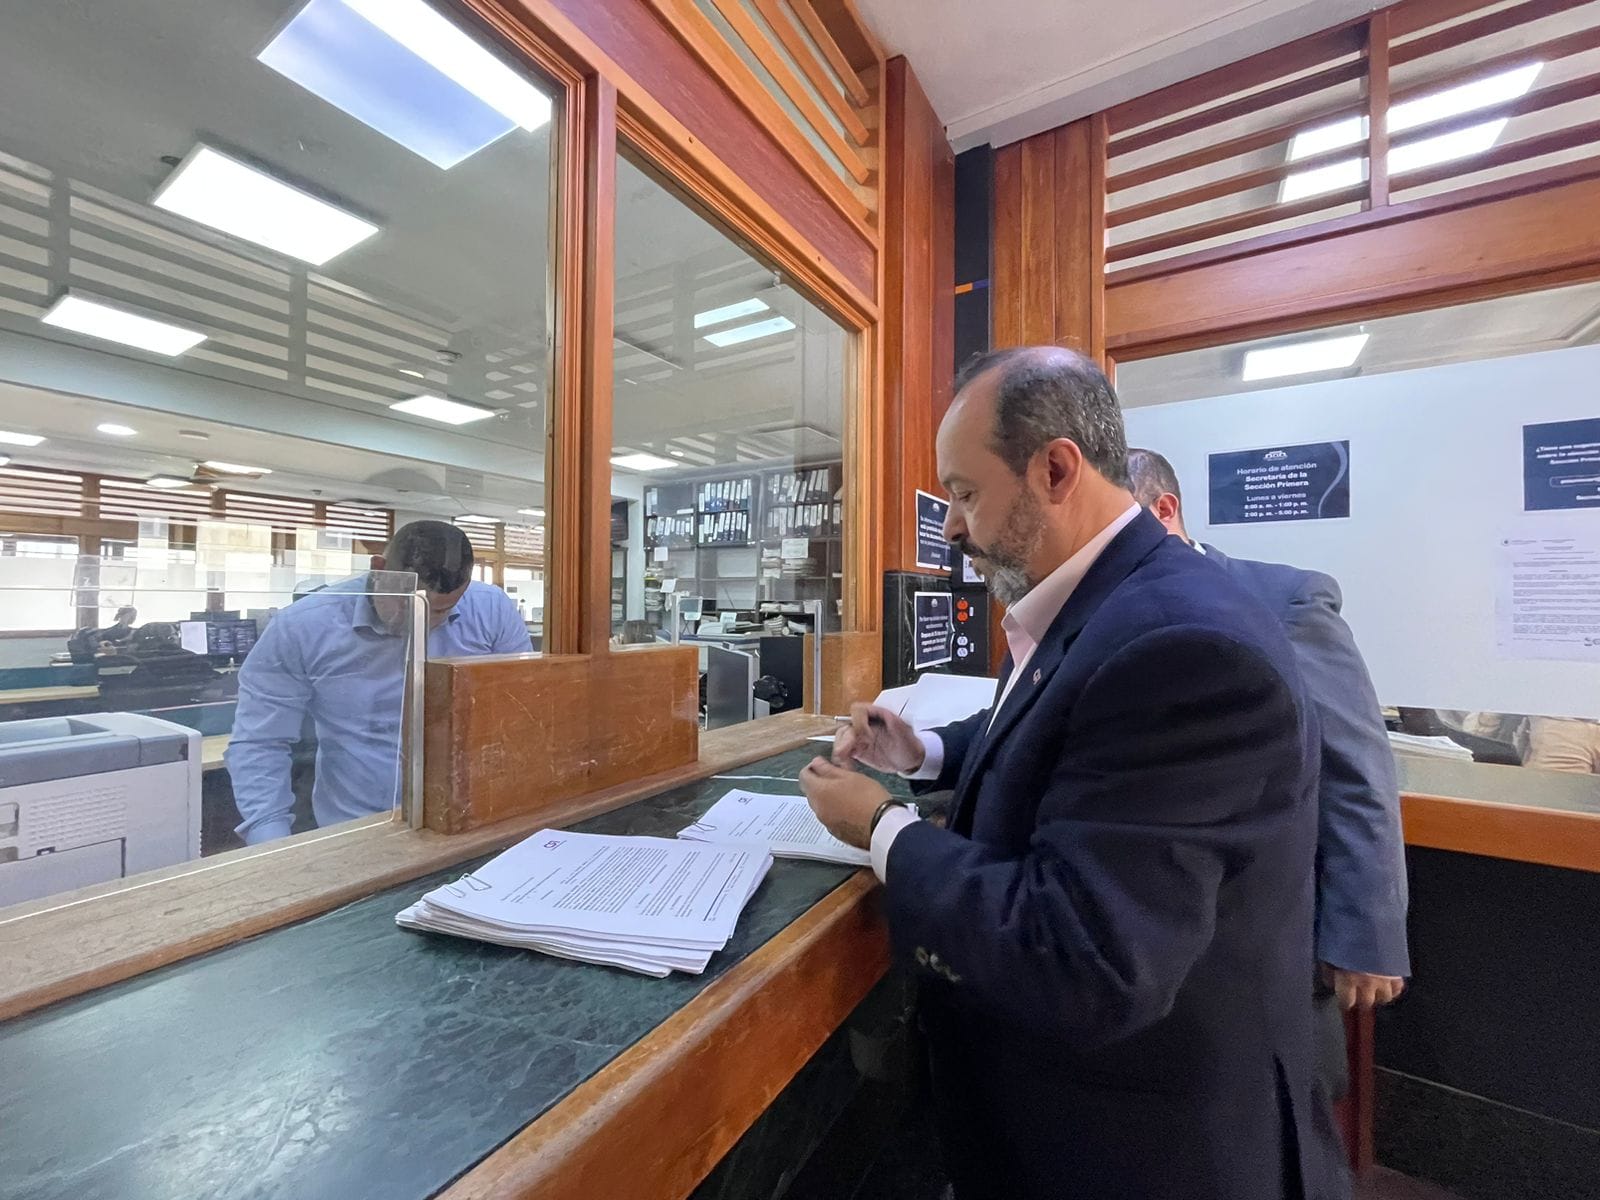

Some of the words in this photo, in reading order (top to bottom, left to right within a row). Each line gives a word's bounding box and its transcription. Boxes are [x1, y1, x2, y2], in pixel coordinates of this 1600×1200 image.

[1281, 462, 1317, 471] atención
[1246, 473, 1286, 482] Secretaría
[1244, 482, 1275, 490] Sección
